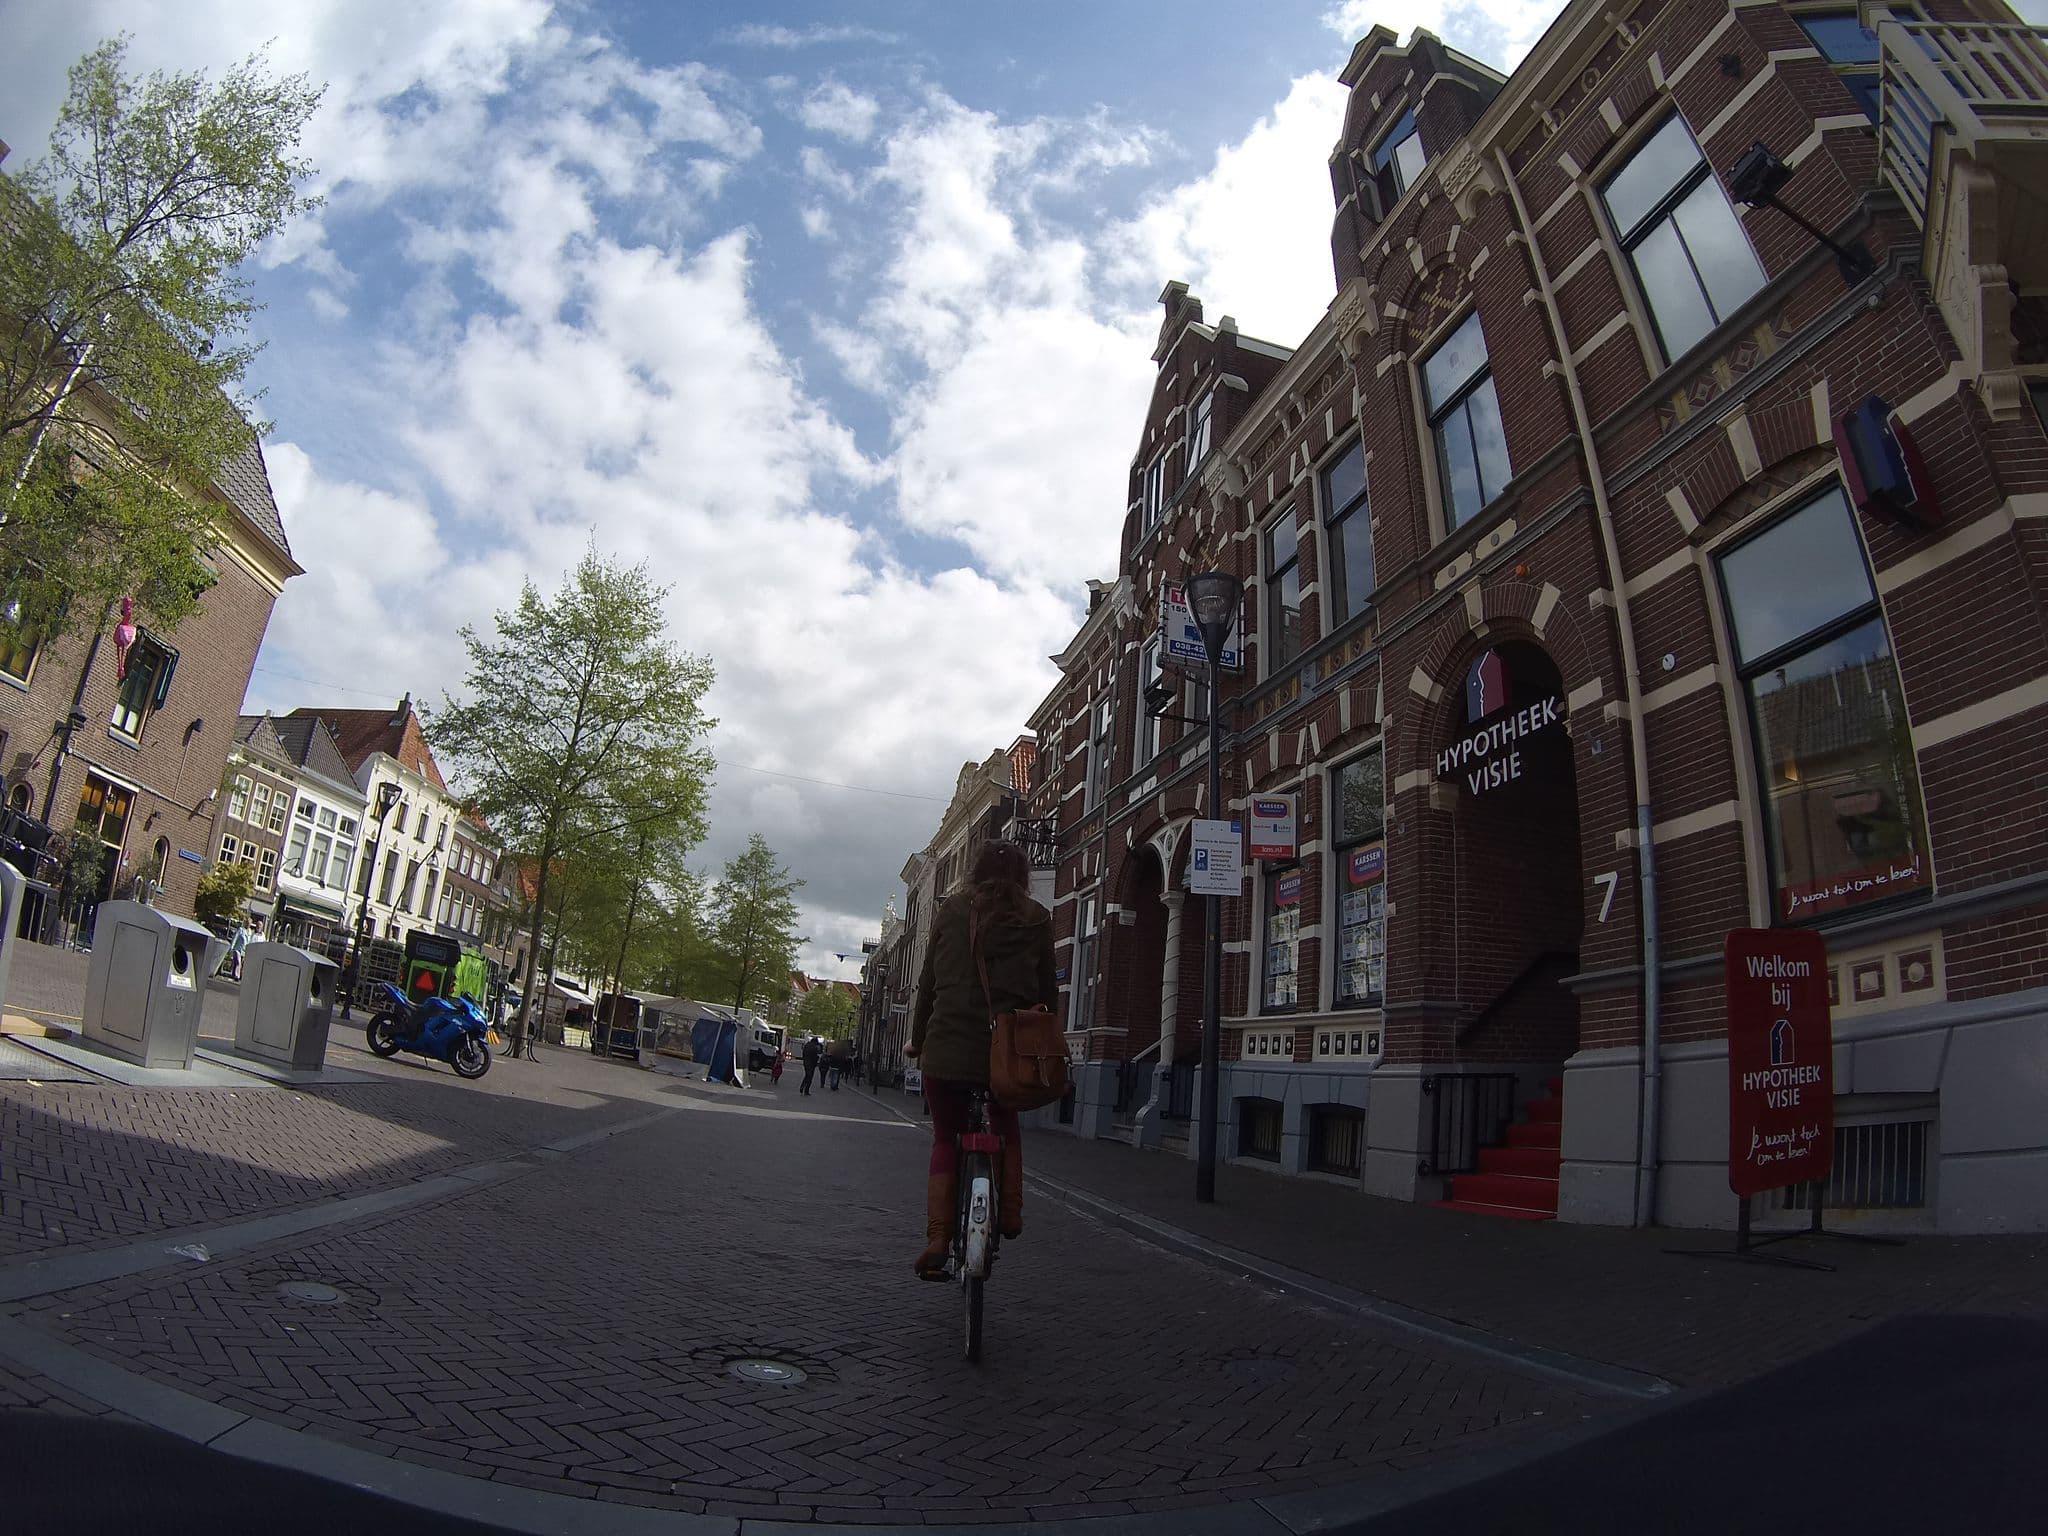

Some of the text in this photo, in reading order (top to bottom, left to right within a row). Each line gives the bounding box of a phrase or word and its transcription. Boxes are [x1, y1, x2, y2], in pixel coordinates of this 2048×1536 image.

[1437, 696, 1556, 775] HYPOTHEEK
[1468, 752, 1521, 795] VISIE
[1197, 851, 1206, 861] P
[1355, 851, 1381, 867] KARSSEN
[1876, 875, 1888, 884] te
[1594, 871, 1618, 923] 7
[1746, 955, 1810, 977] Welkom
[1772, 983, 1791, 1011] bij
[1743, 1066, 1821, 1091] HYPOTHEEK
[1767, 1088, 1801, 1109] VISIE
[1776, 1151, 1786, 1160] te
